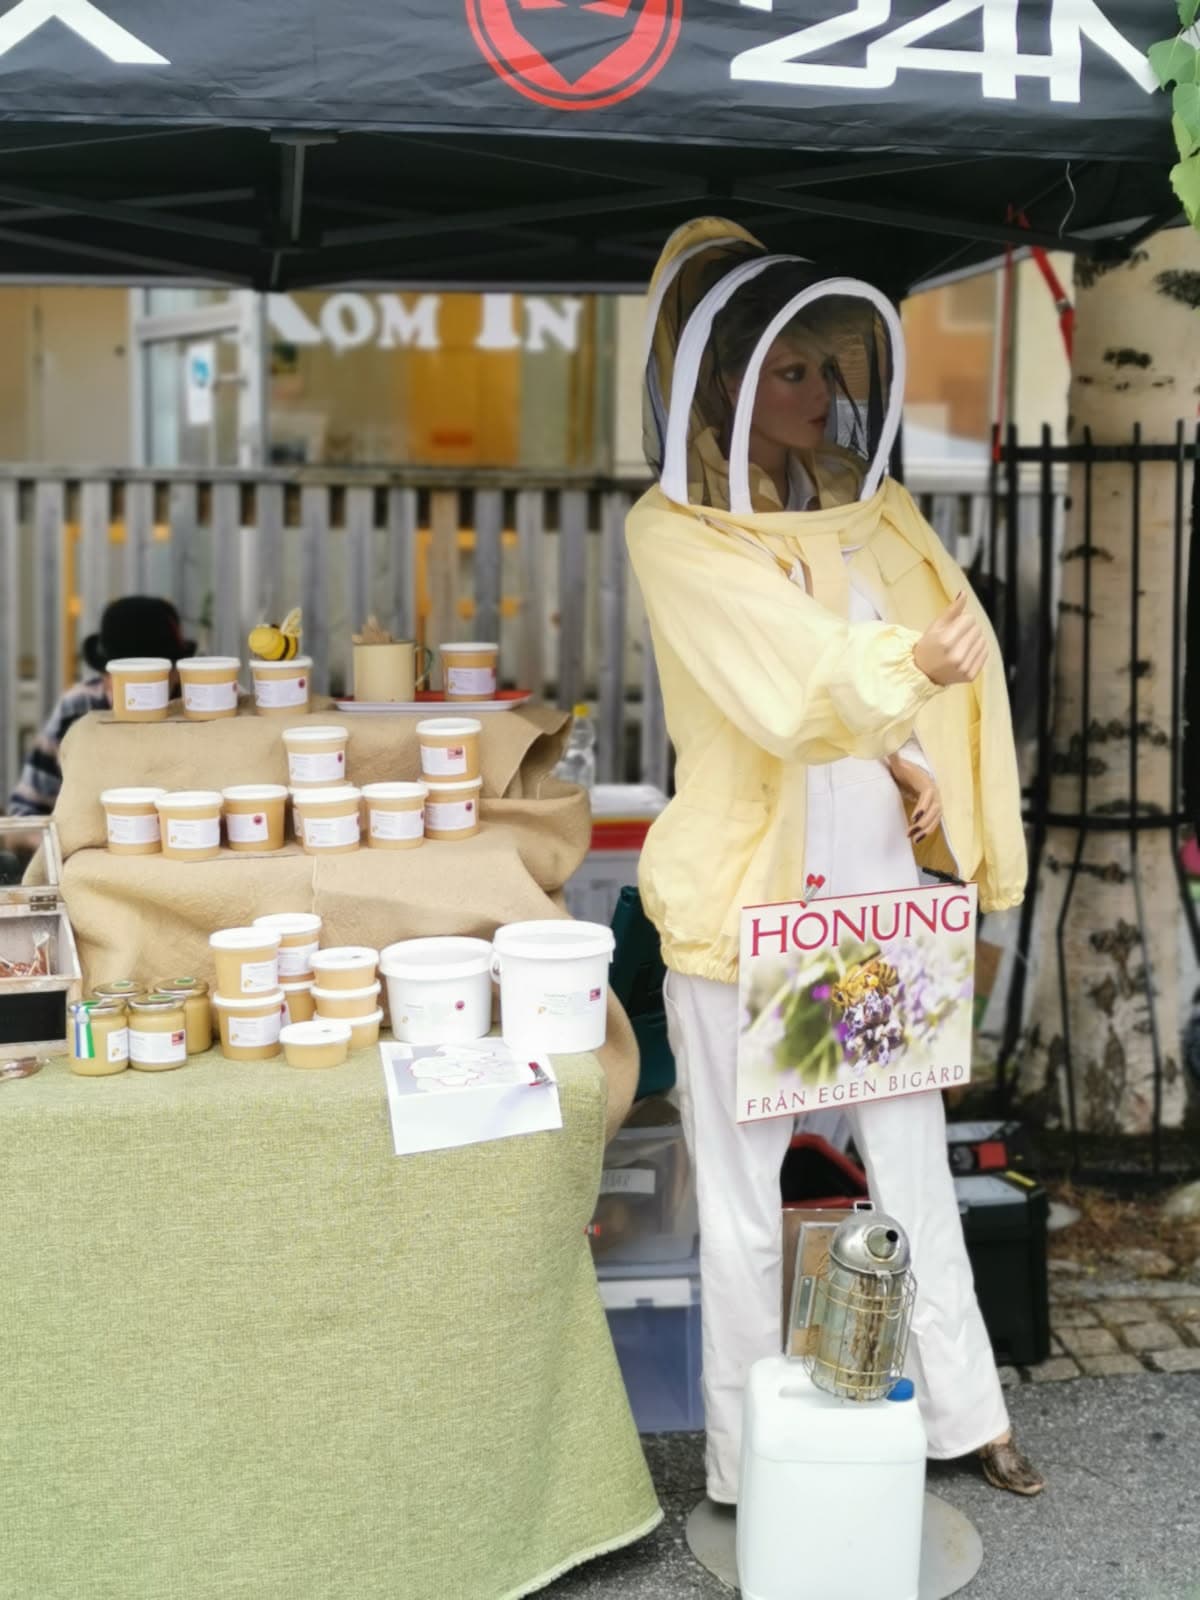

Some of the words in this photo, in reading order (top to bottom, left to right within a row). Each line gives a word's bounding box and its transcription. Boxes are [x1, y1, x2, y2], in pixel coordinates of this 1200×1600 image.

[475, 293, 581, 350] IN
[751, 895, 971, 957] HONUNG
[746, 1089, 806, 1116] FRÅN
[818, 1080, 877, 1104] EGEN
[888, 1064, 965, 1092] BIGÅRD
